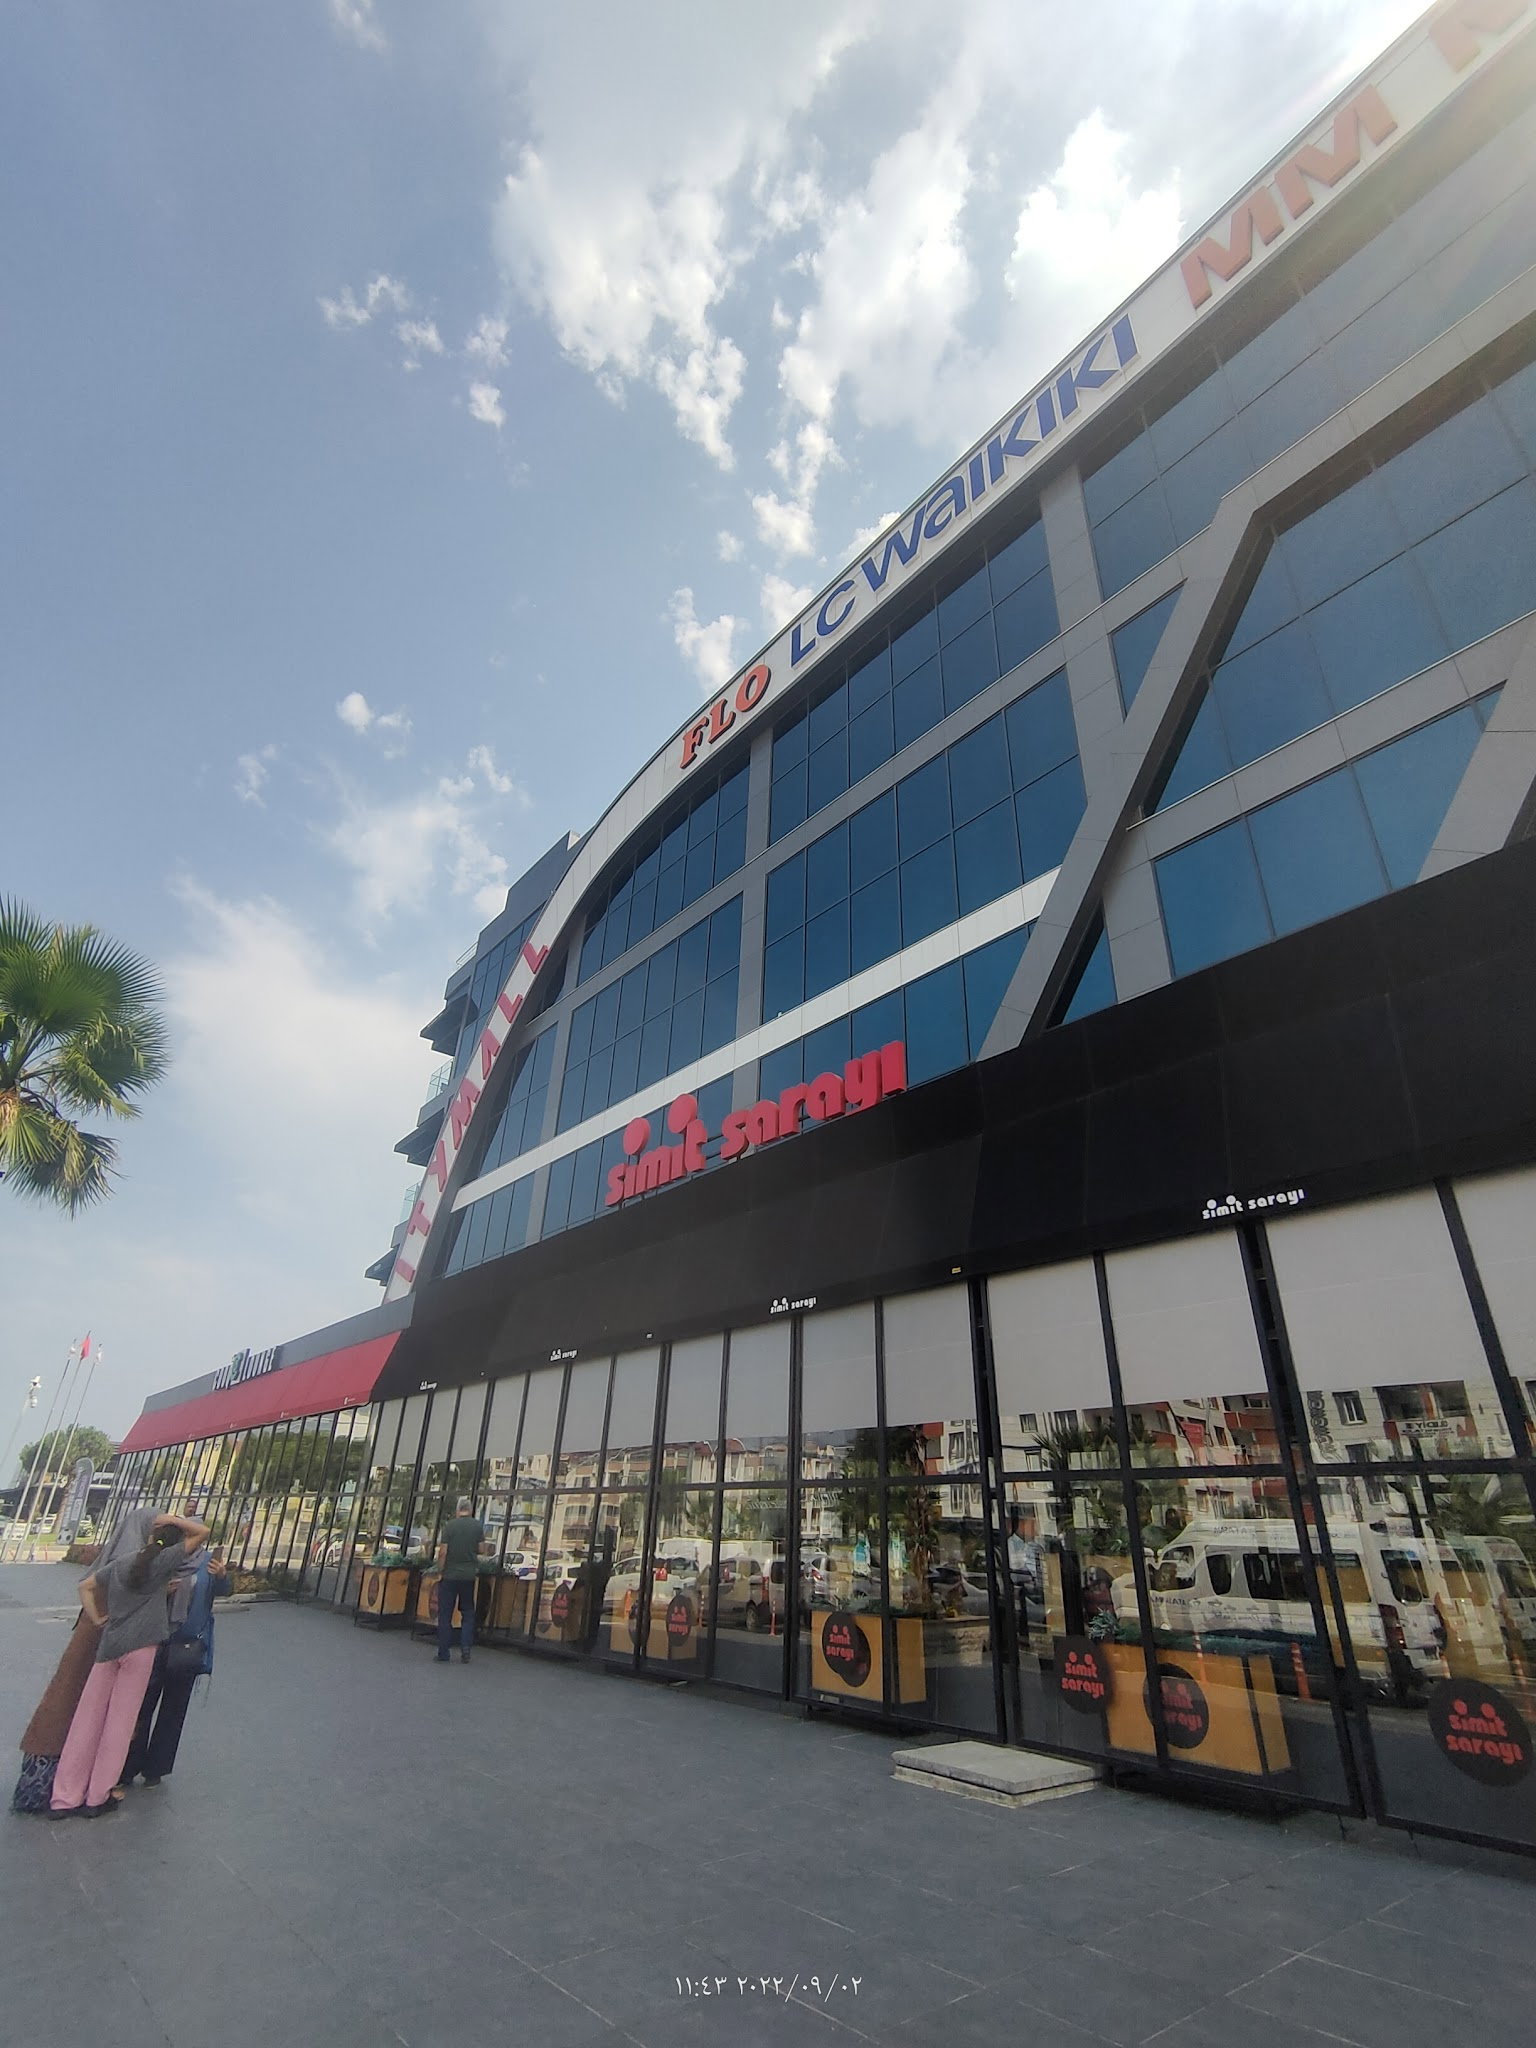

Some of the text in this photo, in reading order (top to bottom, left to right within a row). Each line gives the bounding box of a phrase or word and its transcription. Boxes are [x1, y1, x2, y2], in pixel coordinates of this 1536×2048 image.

[790, 581, 857, 668] LC
[680, 664, 772, 769] FLO
[386, 942, 549, 1302] ITYMALL
[605, 1093, 708, 1207] simit
[1202, 1195, 1244, 1219] simit
[1065, 1651, 1098, 1679] simit
[1448, 1699, 1508, 1737] simit
